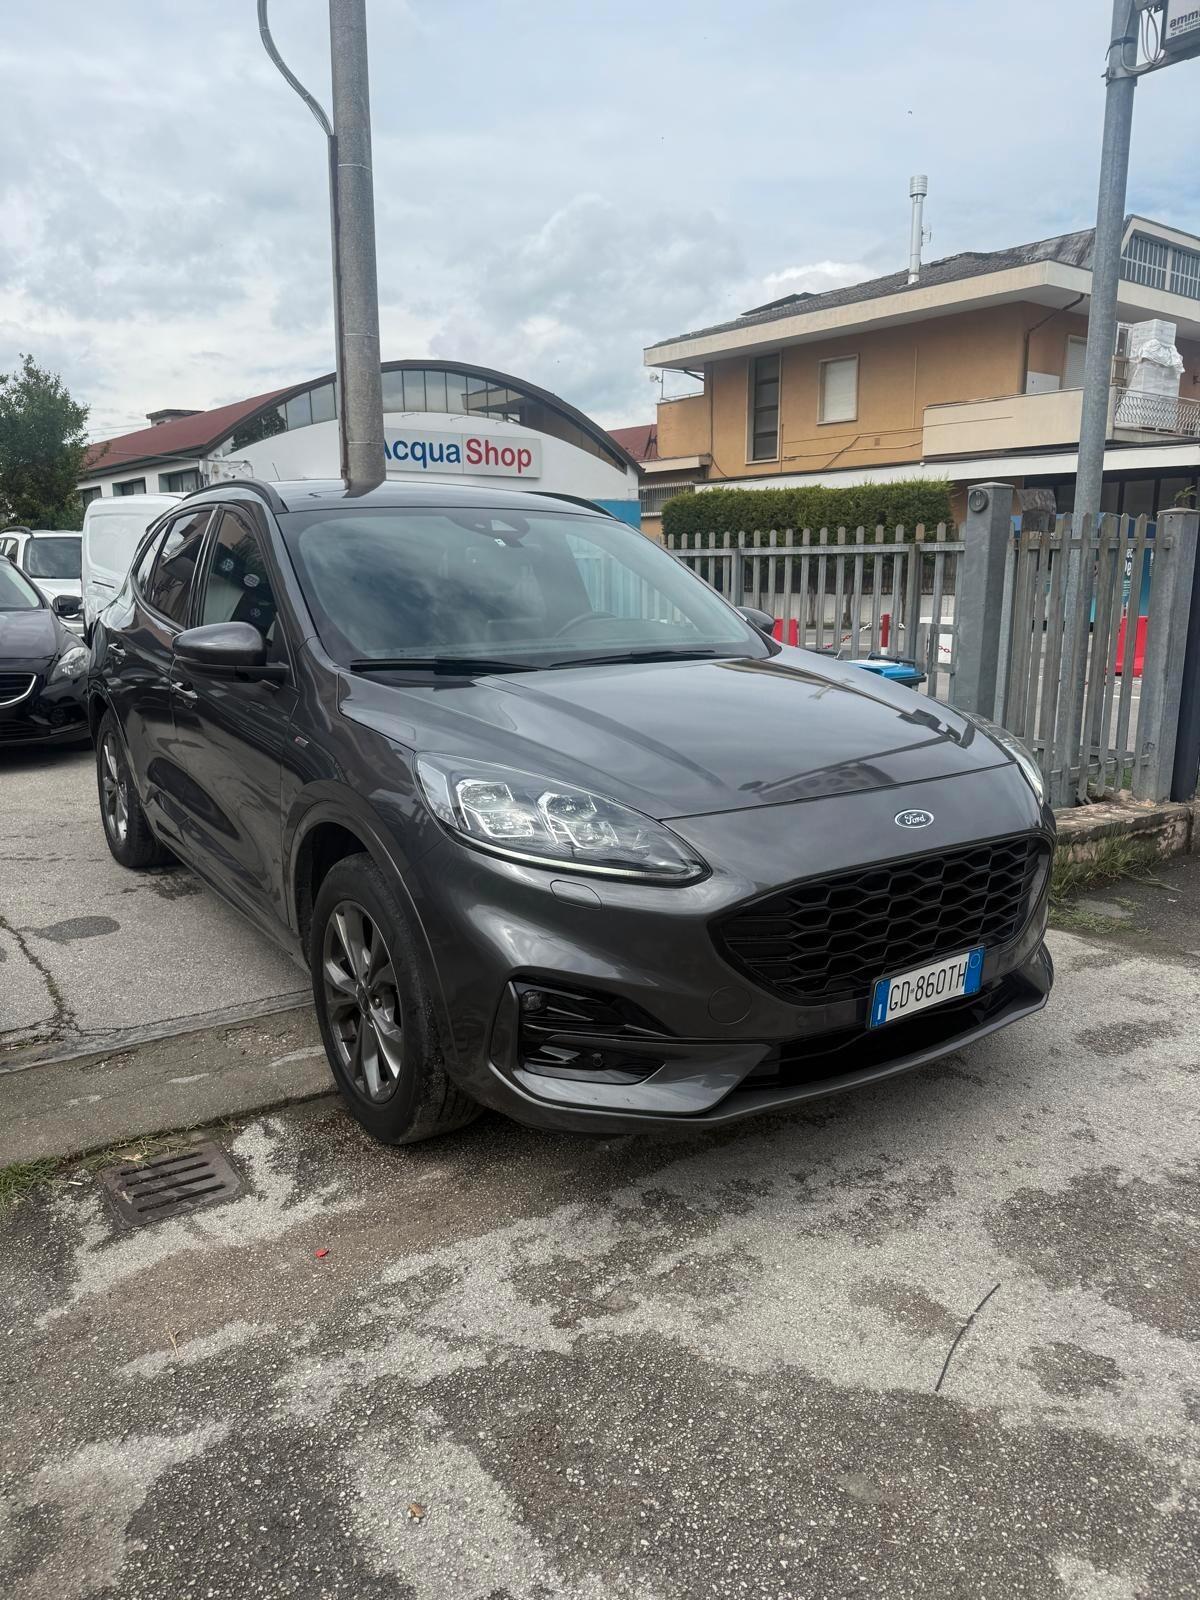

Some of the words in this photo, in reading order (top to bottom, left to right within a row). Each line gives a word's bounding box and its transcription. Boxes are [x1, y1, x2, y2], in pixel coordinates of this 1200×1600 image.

[1170, 10, 1200, 28] amm
[466, 438, 532, 474] Shop
[904, 813, 926, 825] Ford
